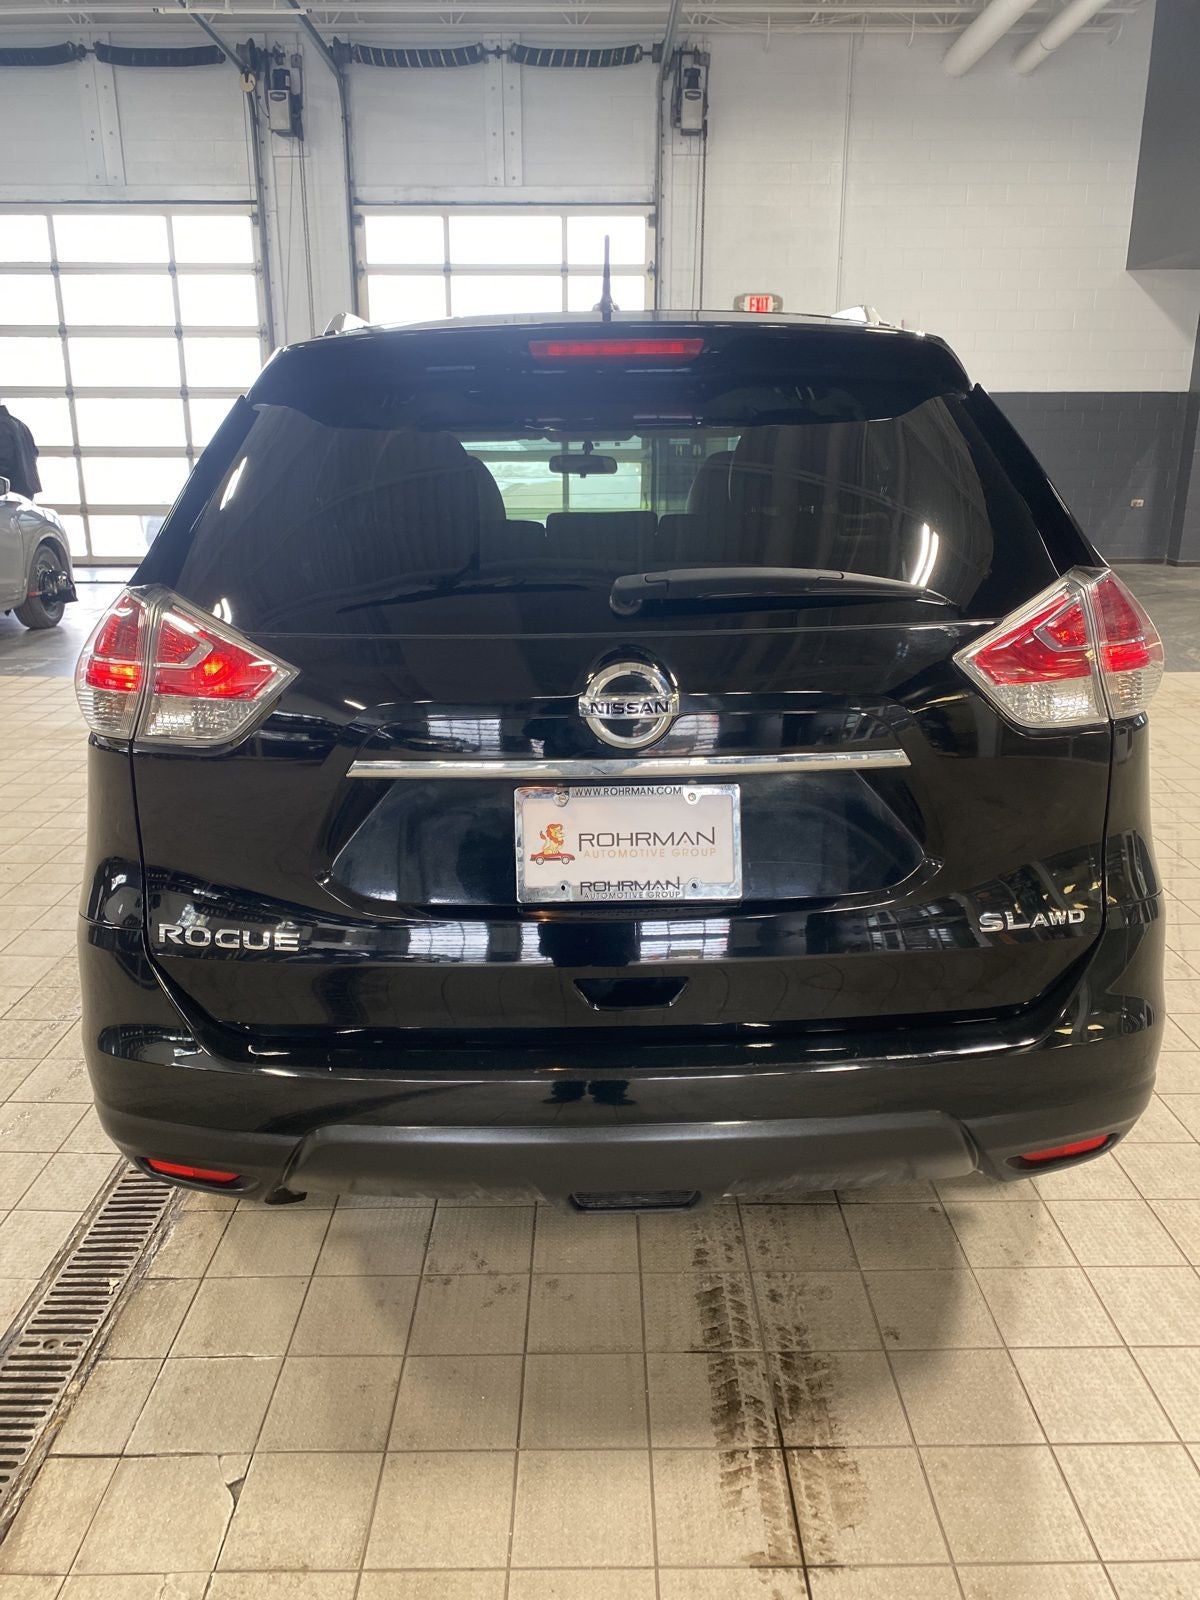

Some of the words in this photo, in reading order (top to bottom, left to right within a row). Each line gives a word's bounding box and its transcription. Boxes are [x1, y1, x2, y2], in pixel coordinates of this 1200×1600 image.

[749, 296, 769, 311] EXIT
[590, 701, 669, 715] NISSAN
[575, 786, 682, 797] WWW.ROHRMAN.COM
[578, 826, 716, 852] ROHRMAN
[584, 850, 665, 859] AUTOMOTIVE
[672, 848, 717, 858] GROUP
[580, 876, 680, 896] ROHRMAN
[584, 891, 644, 900] AUTOMOTIVE
[648, 890, 681, 899] GROUP
[158, 923, 300, 952] ROGUE
